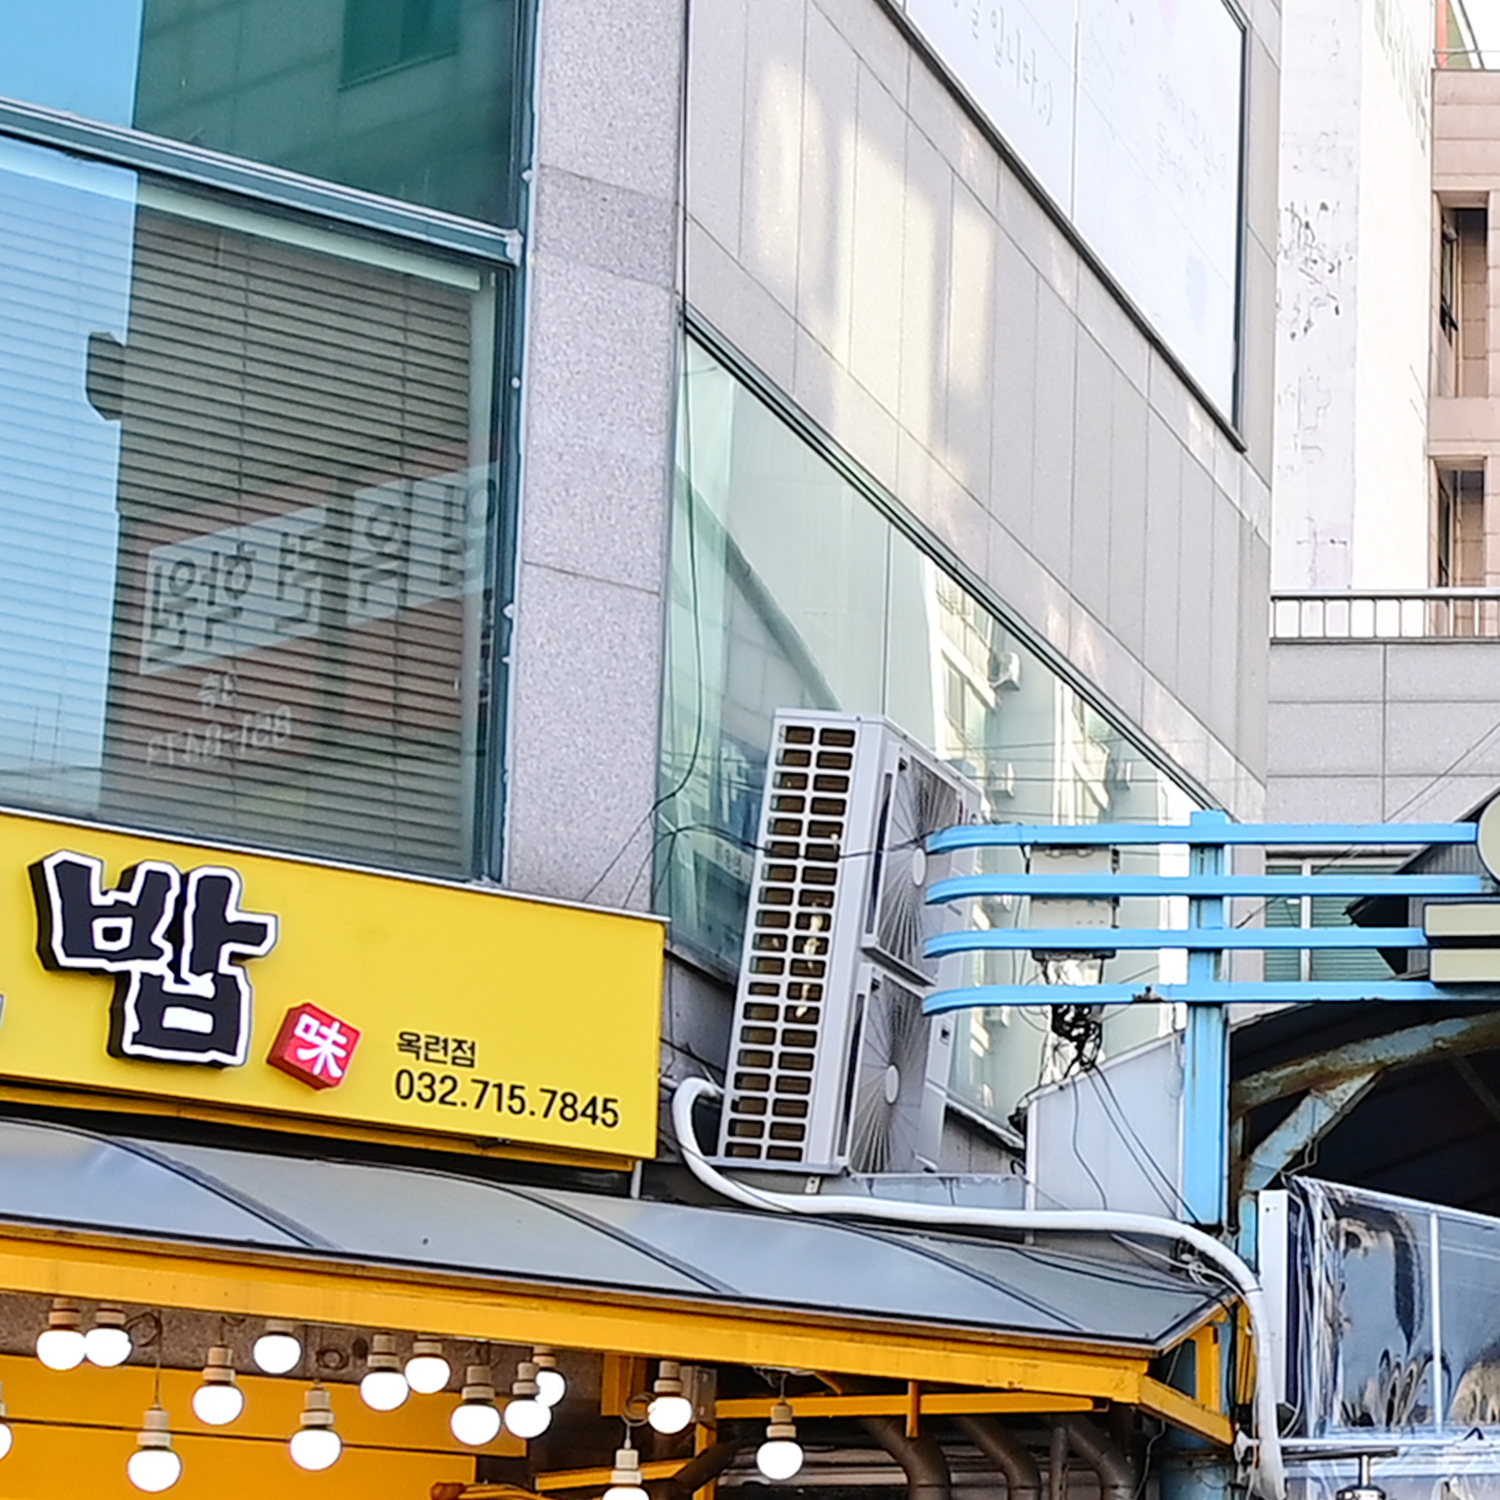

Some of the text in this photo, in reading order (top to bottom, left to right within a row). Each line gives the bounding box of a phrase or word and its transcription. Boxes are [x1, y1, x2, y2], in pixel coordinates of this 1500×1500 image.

[28, 850, 278, 1068] 밥
[294, 1012, 348, 1080] 味
[396, 1030, 477, 1069] 옥련점
[395, 1069, 621, 1129] 032.715.7845
